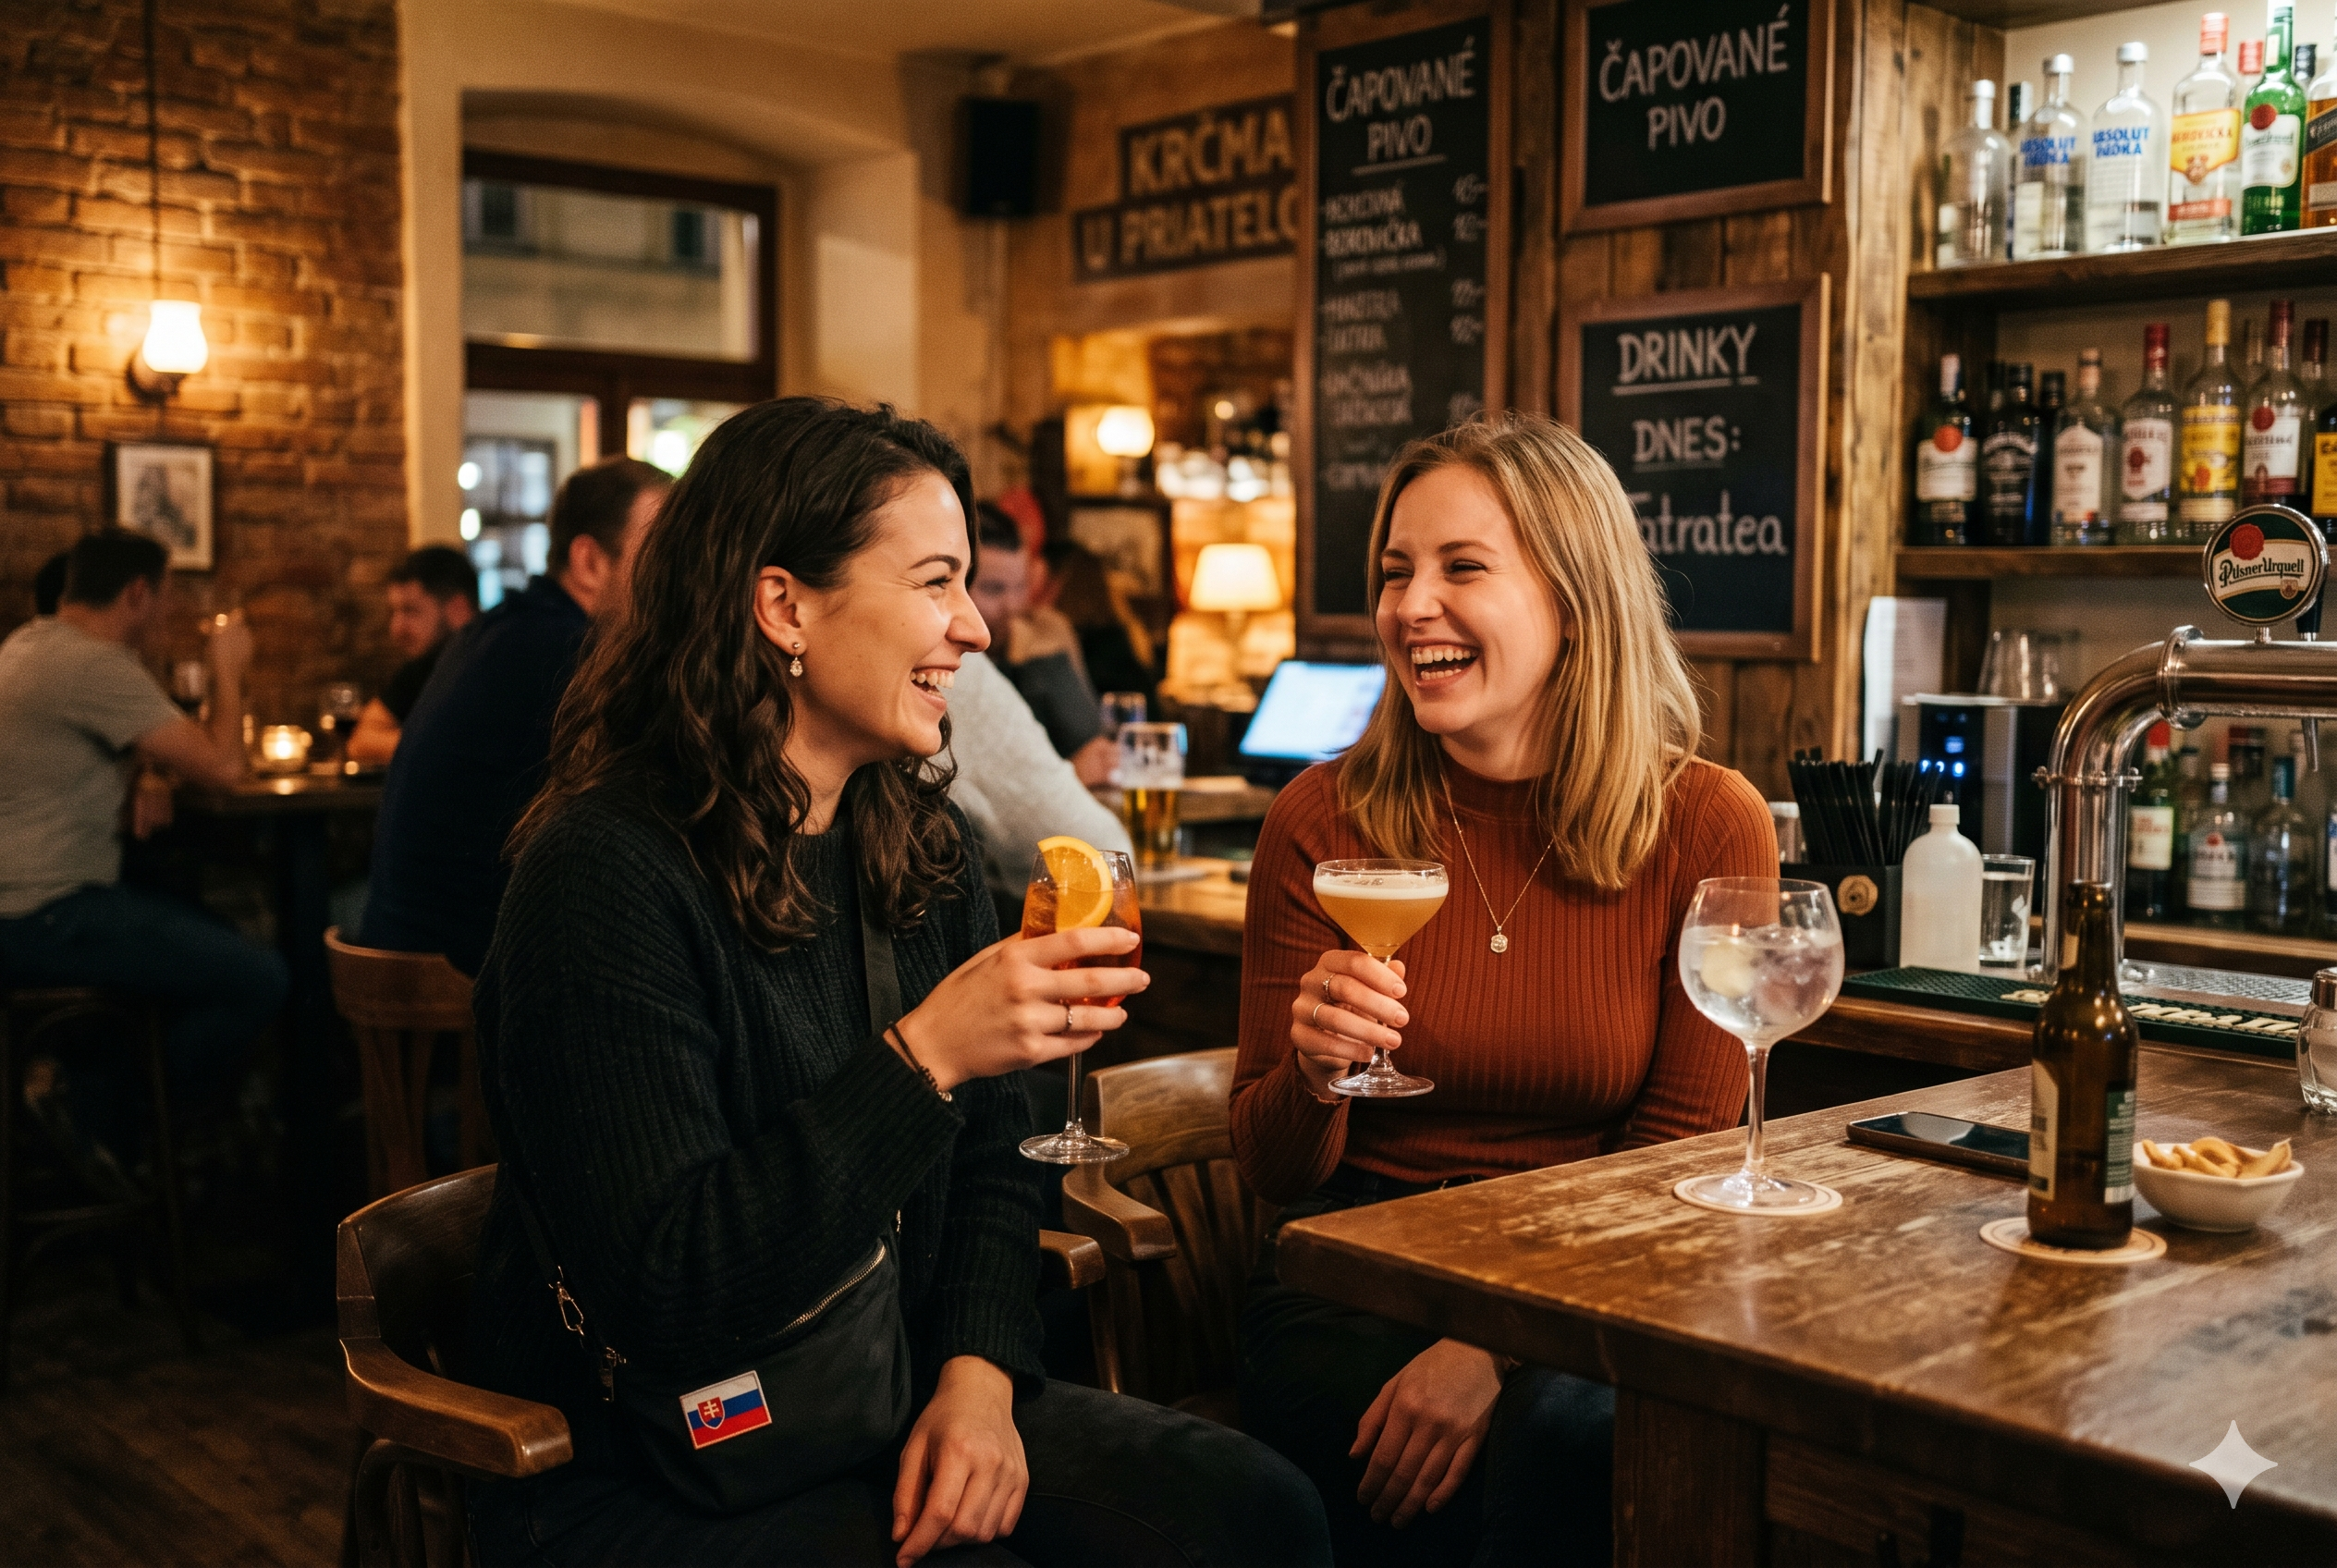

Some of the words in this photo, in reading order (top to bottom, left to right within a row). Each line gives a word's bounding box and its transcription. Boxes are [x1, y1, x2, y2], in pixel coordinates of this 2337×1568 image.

[1326, 34, 1476, 123] ČAPOVANÉ
[1598, 3, 1790, 103] ČAPOVANÉ
[1366, 114, 1434, 163] PIVO
[1646, 95, 1727, 151] PIVO
[1129, 109, 1294, 197] KRČMA
[1618, 323, 1757, 384] DRINKY
[1633, 415, 1742, 463] DNES:
[2262, 557, 2305, 579] Urquell
